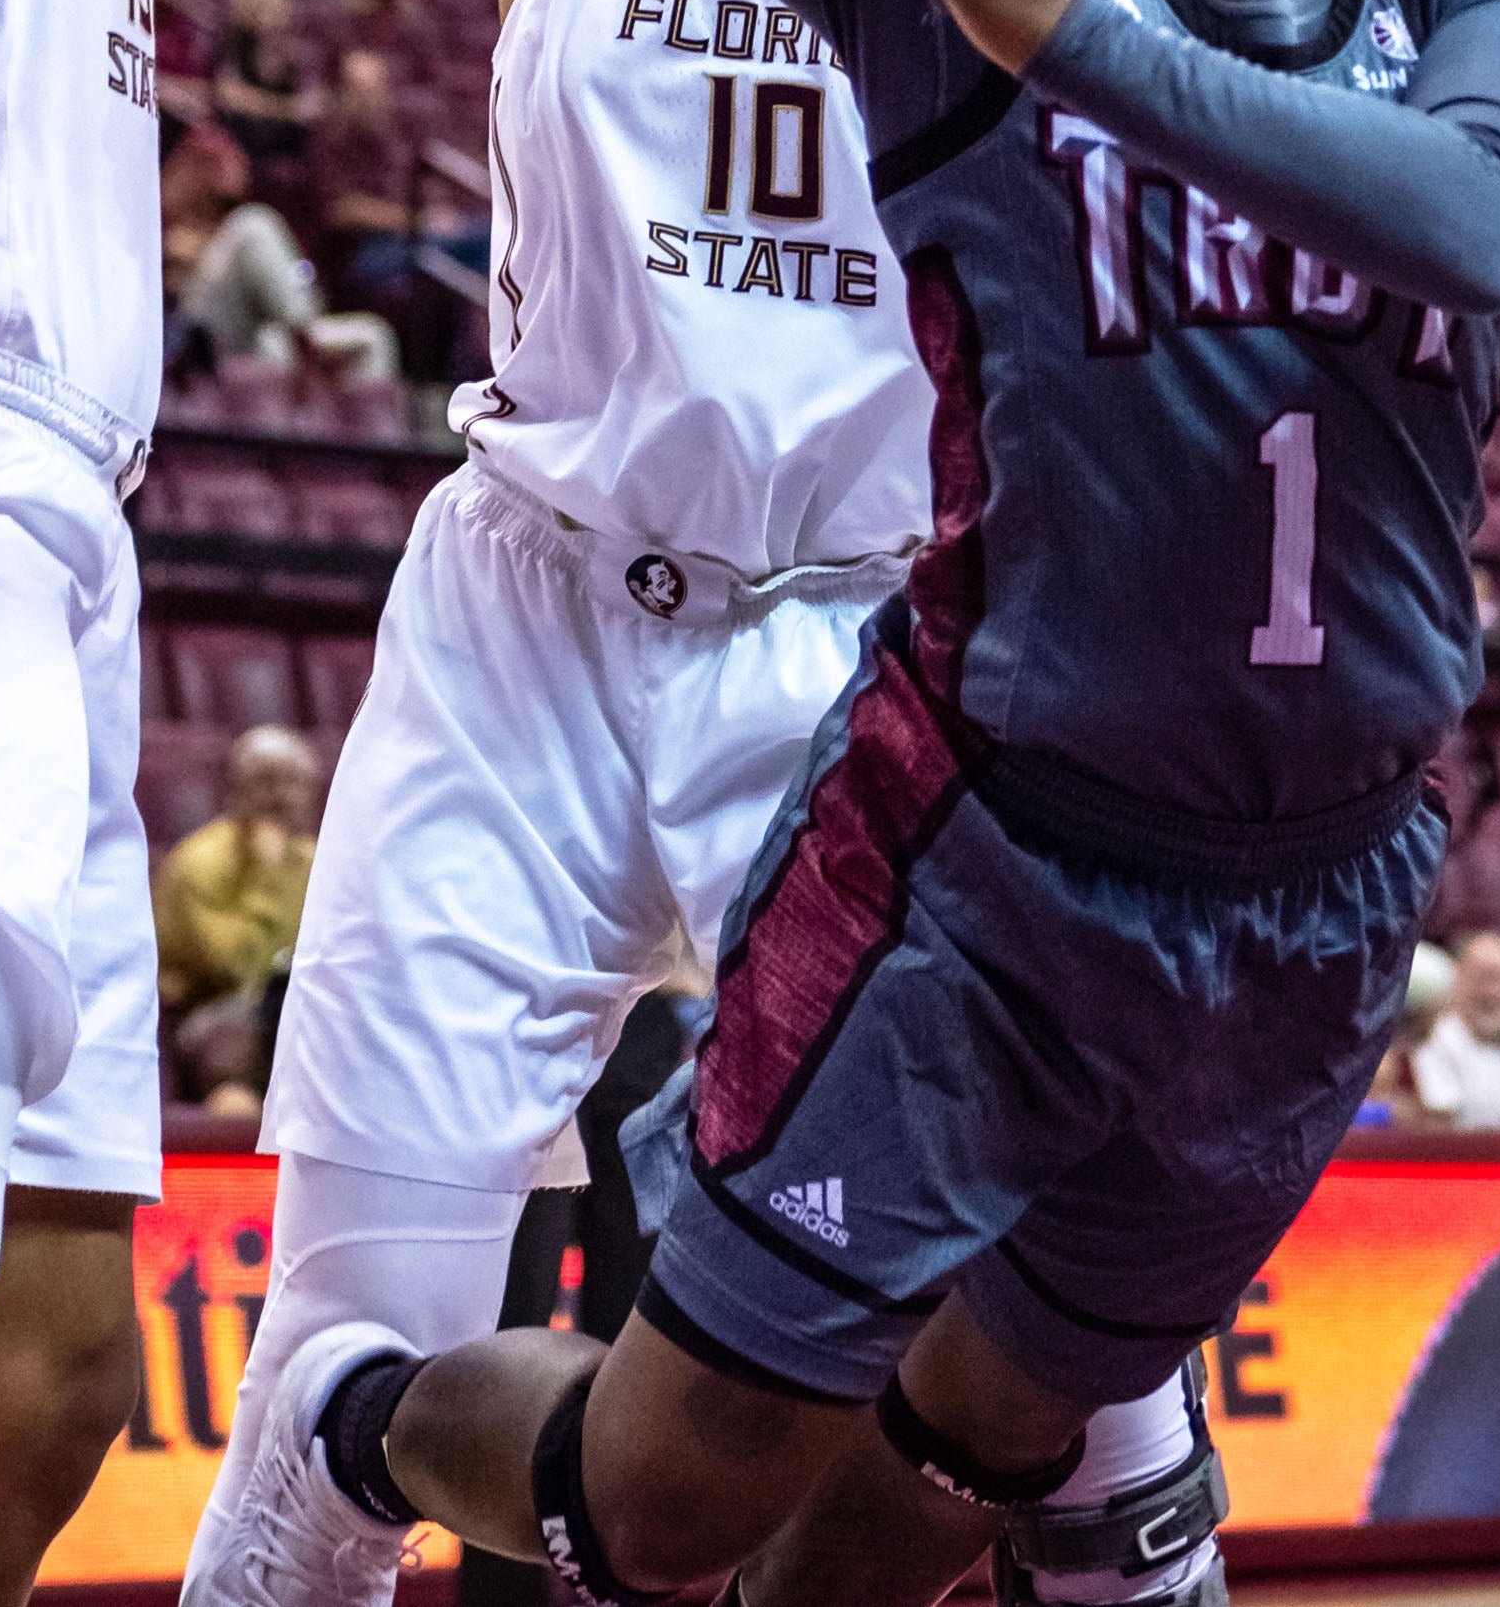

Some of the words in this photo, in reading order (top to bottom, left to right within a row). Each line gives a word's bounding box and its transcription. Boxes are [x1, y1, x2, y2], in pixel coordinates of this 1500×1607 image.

[704, 74, 825, 223] 10
[646, 220, 877, 307] STATE
[1250, 411, 1324, 665] 1
[768, 1191, 849, 1249] adidas
